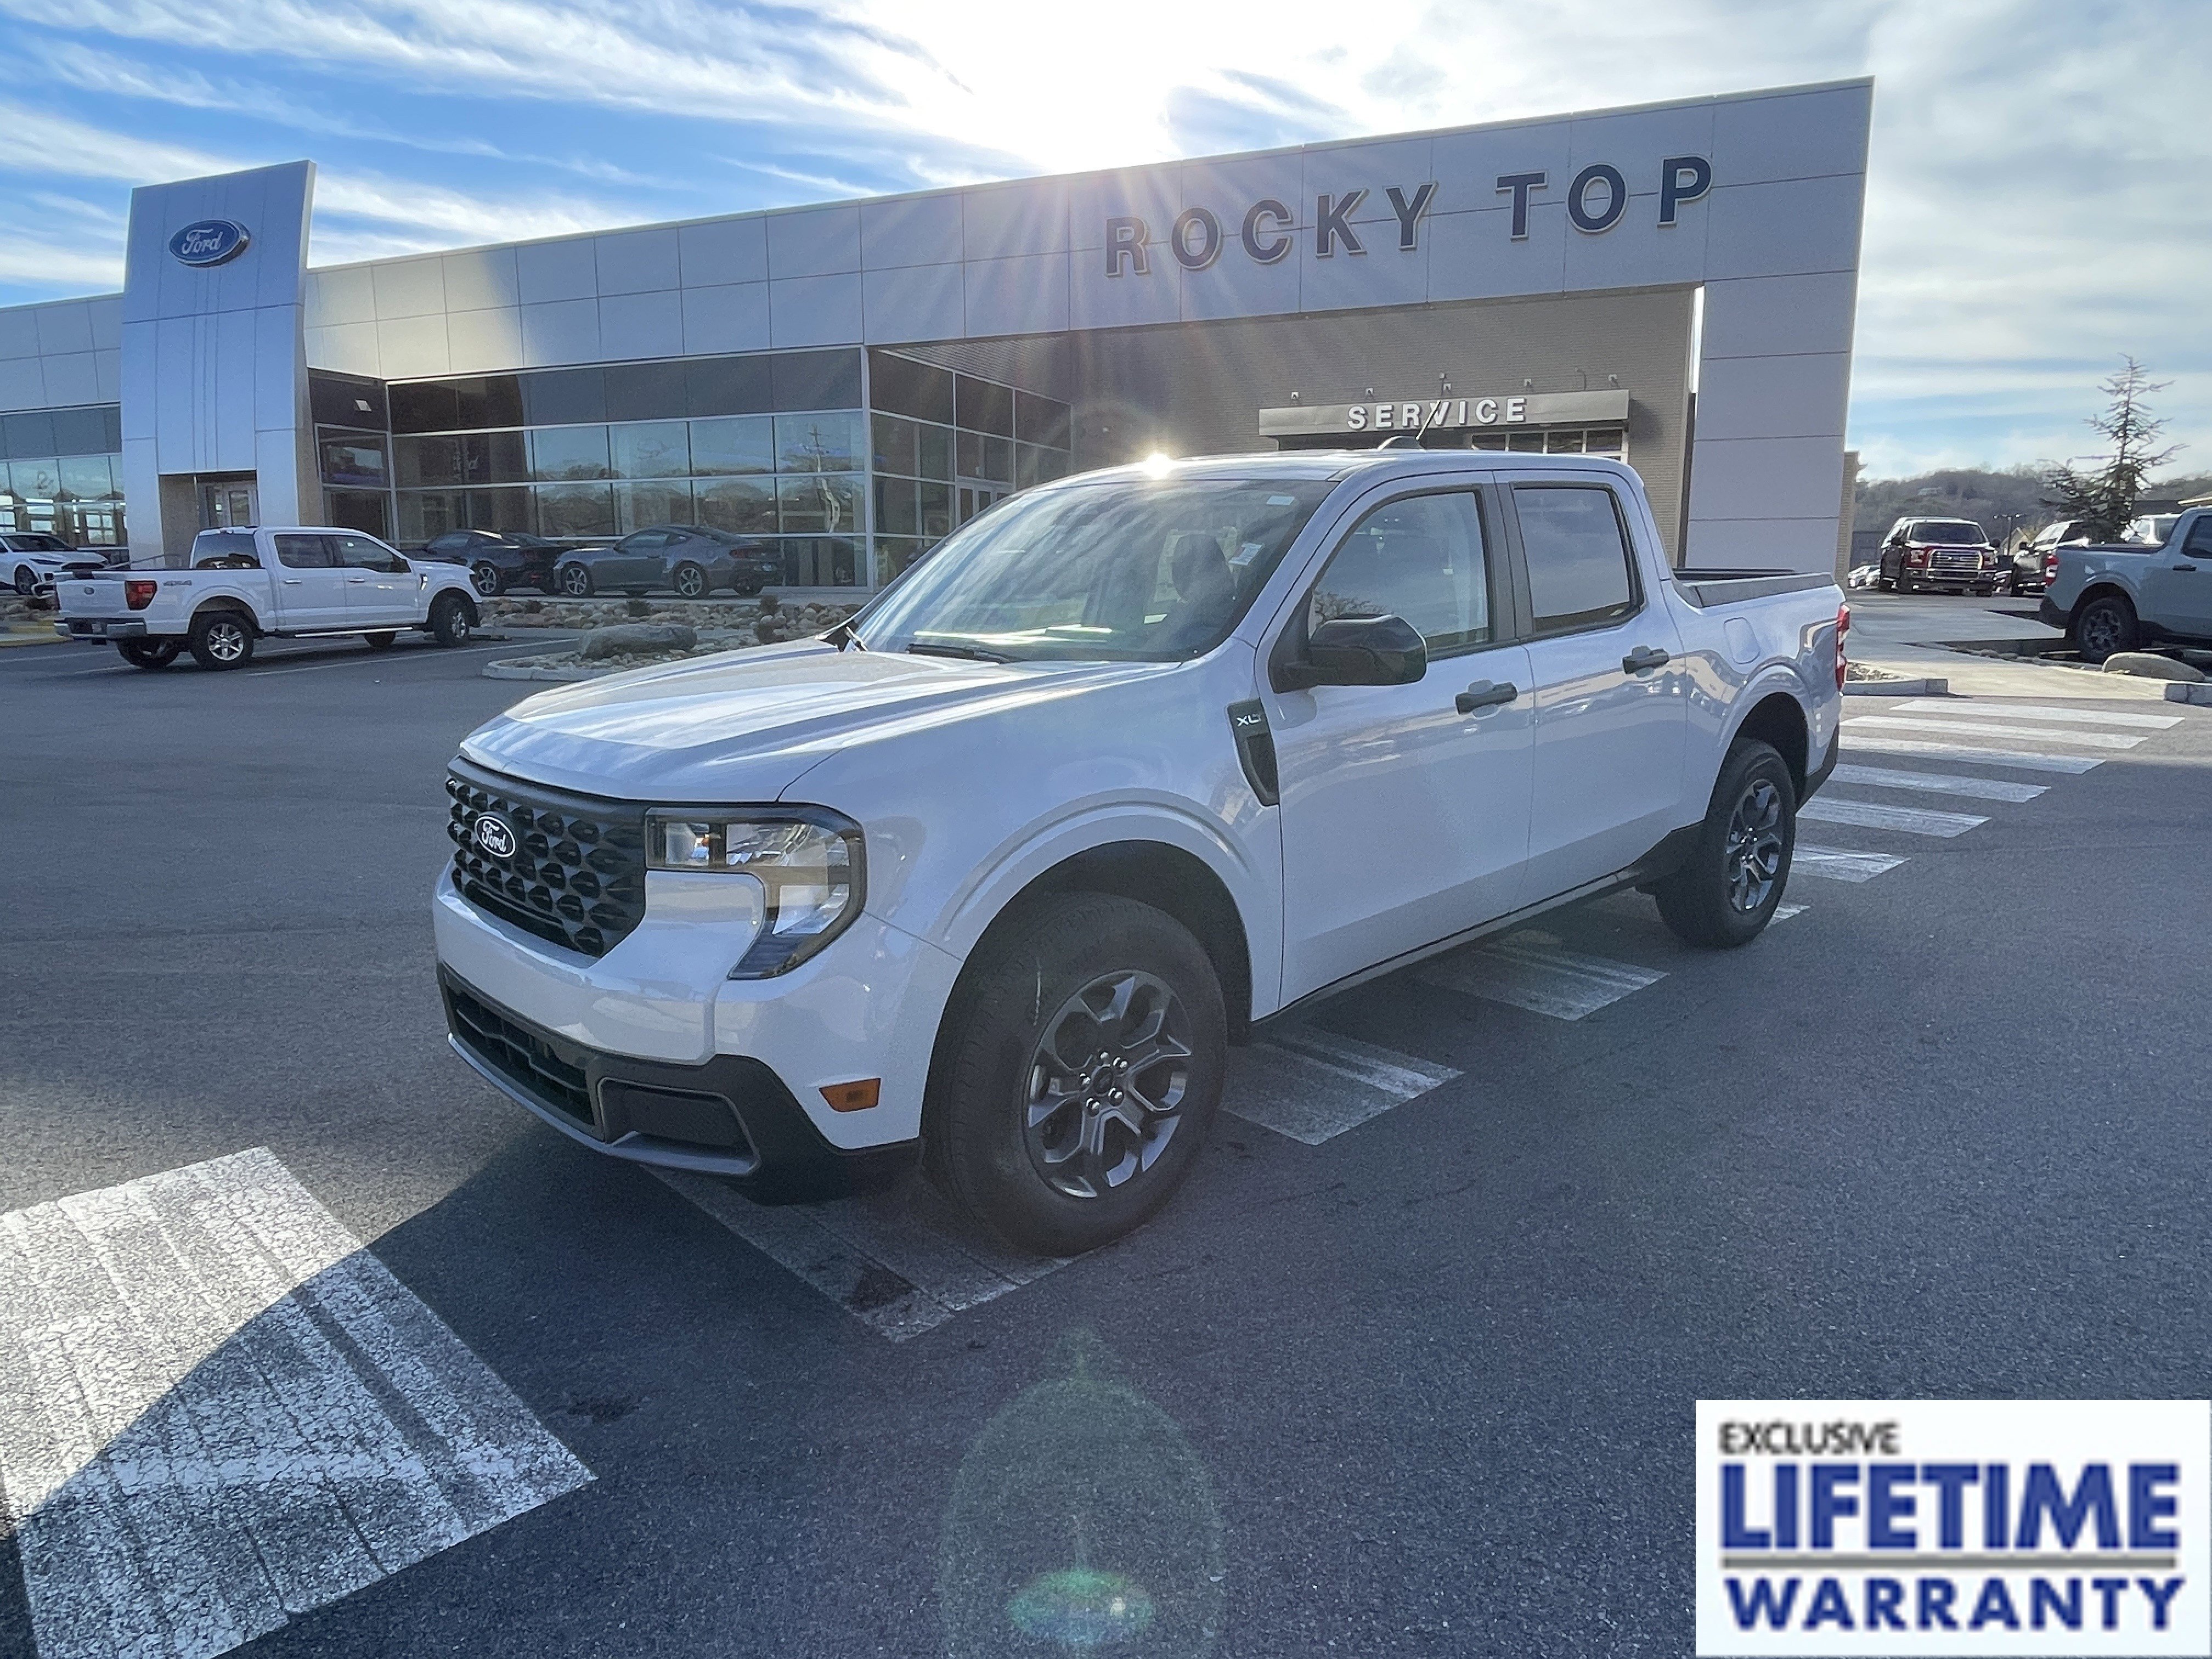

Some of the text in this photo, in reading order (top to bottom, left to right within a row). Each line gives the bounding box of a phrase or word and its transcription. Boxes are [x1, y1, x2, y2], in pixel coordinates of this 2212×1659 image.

[1105, 154, 1712, 277] ROCKY TOP
[182, 228, 223, 255] Ford
[1347, 398, 1526, 431] SERVICE
[482, 821, 507, 852] Ford
